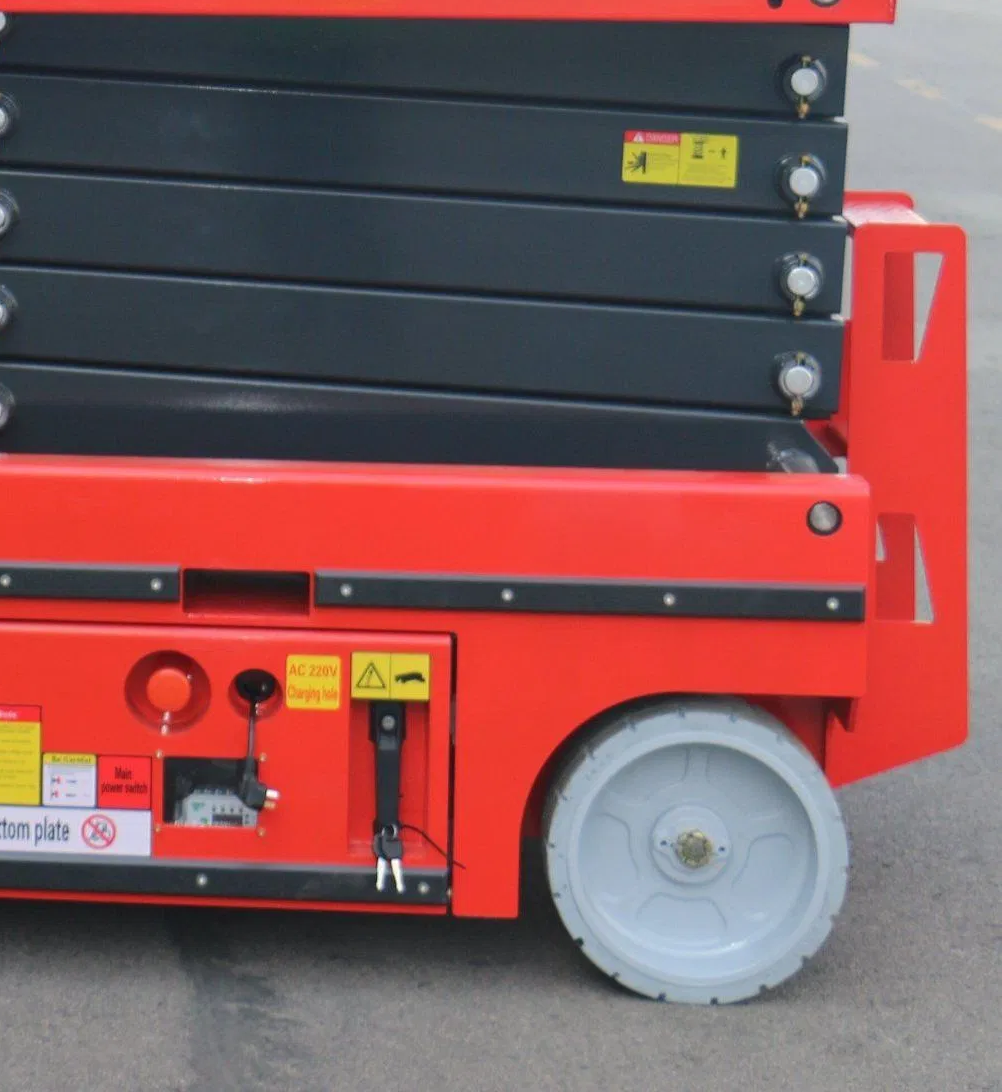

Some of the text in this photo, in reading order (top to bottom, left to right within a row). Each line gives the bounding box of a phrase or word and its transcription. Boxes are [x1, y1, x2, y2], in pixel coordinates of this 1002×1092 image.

[289, 664, 338, 677] AC 220V
[288, 686, 338, 704] Charging hole
[114, 766, 132, 779] Main
[101, 782, 148, 794] power switch
[34, 816, 70, 846] plate
